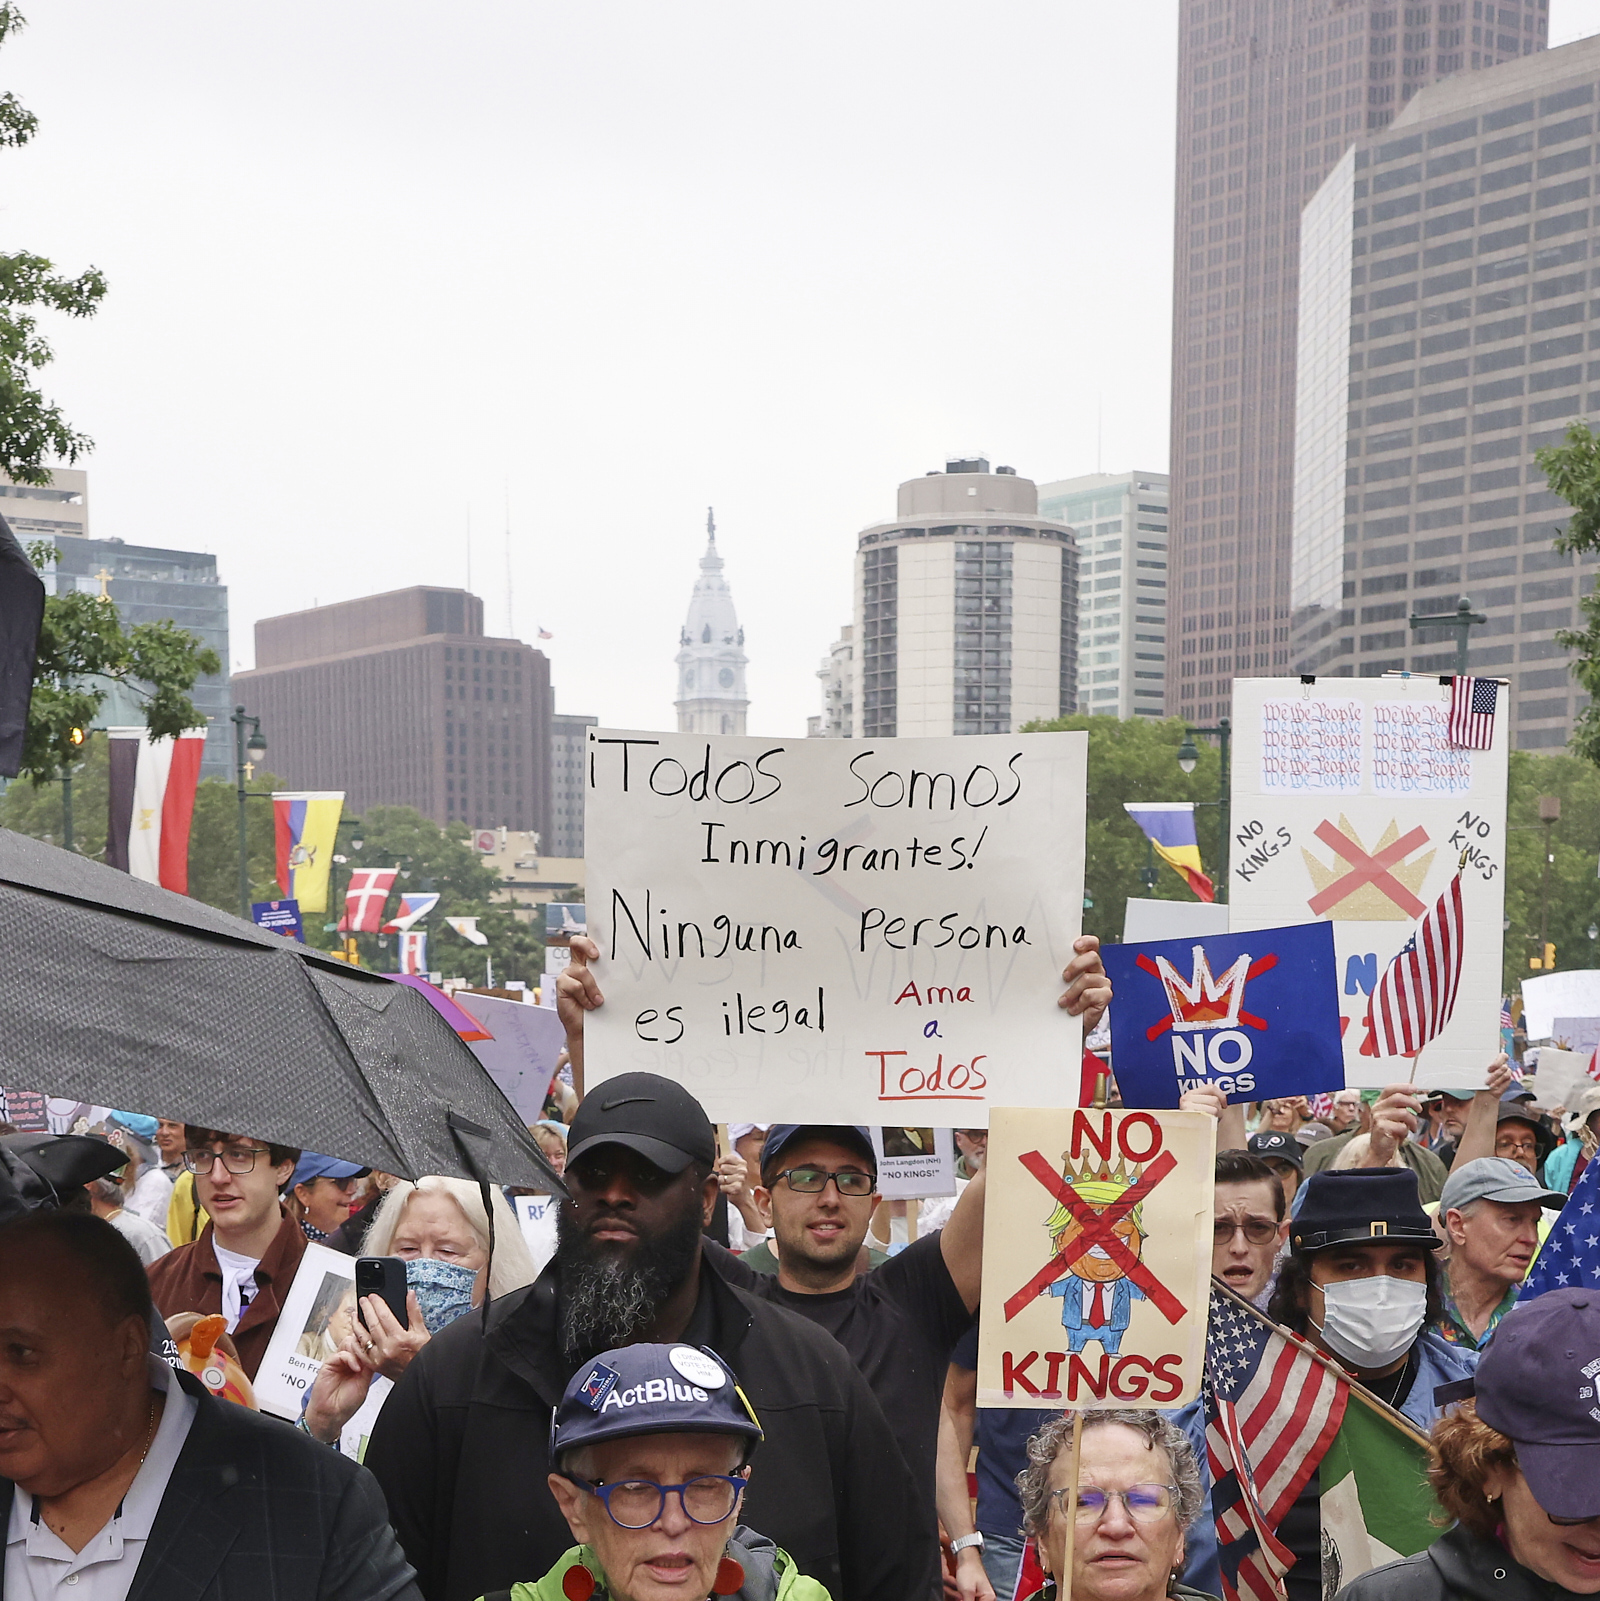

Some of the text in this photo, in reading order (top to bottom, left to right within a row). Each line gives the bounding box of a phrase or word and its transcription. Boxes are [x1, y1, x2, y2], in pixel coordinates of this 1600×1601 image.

[1236, 820, 1263, 847] NO
[1457, 811, 1490, 838] NO
[700, 821, 986, 875] Inmigrantes!
[1236, 827, 1291, 882] KINGS
[611, 889, 802, 960] Ninguna
[895, 982, 973, 1004] Ama
[1345, 953, 1377, 995] N
[635, 986, 826, 1043] es ilegal
[924, 1020, 942, 1038] a
[865, 1051, 987, 1093] Todos
[1172, 1031, 1253, 1076] NO
[1177, 1073, 1255, 1096] KINGS
[1072, 1109, 1161, 1162] NO
[288, 1356, 321, 1375] Ben Fra
[1003, 1351, 1183, 1402] KINGS
[589, 1373, 615, 1407] INDIVISIBLE
[601, 1378, 709, 1414] ActBlue
